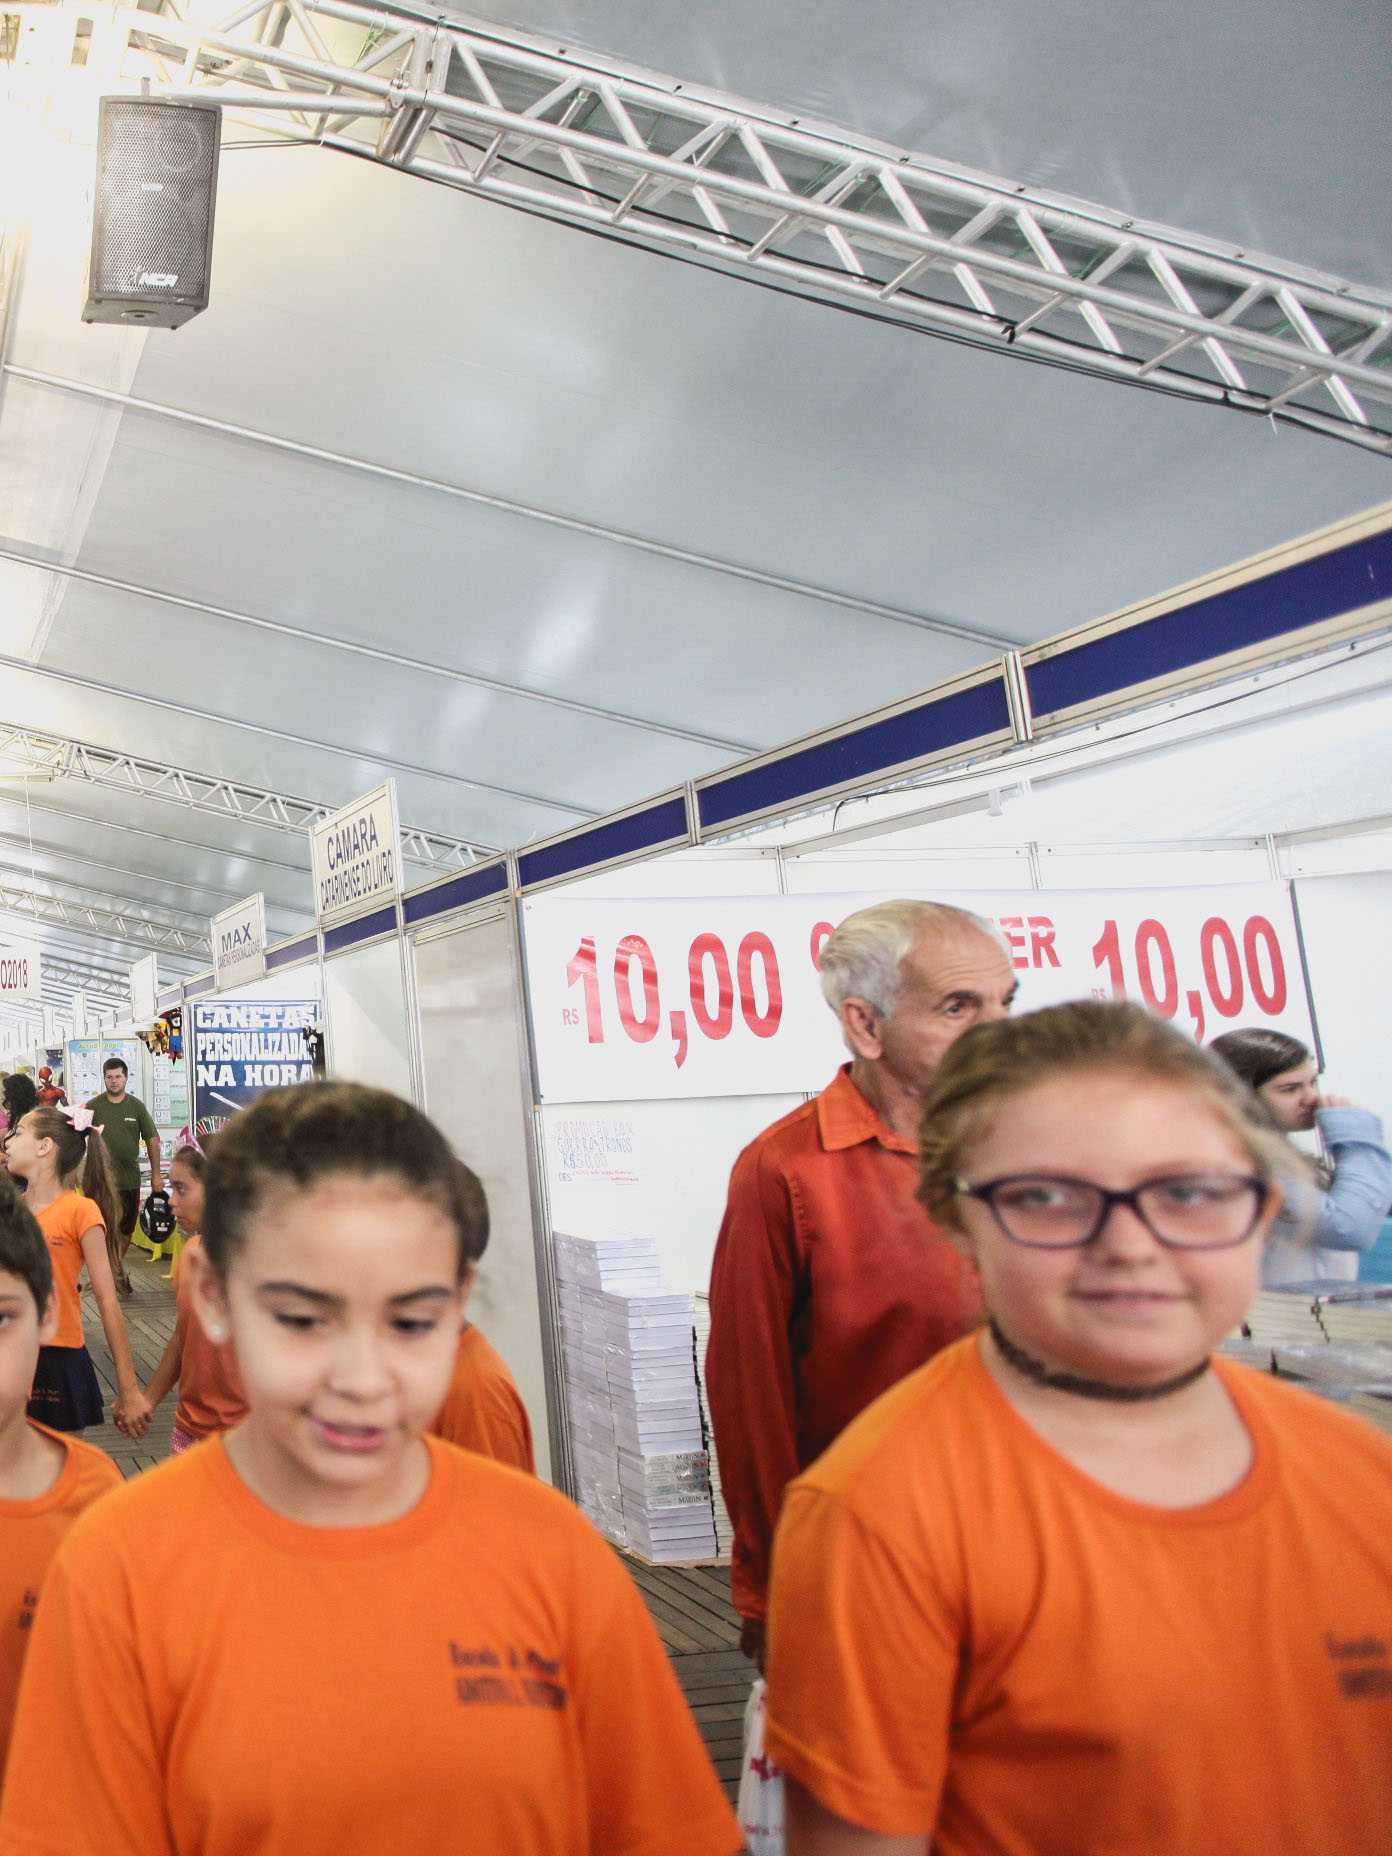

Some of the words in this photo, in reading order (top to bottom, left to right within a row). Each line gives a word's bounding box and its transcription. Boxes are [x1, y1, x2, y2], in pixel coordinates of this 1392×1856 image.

[327, 812, 379, 871] CÂMARA
[320, 864, 361, 911] CATARINENSE
[361, 859, 372, 895] DO
[372, 849, 394, 890] LIVRO
[221, 921, 252, 953] MAX
[566, 931, 783, 1070] 10,00
[1092, 915, 1287, 1046] 10,00
[196, 1005, 316, 1029] CANETAS
[196, 1064, 237, 1087] NA
[244, 1064, 314, 1087] HORA
